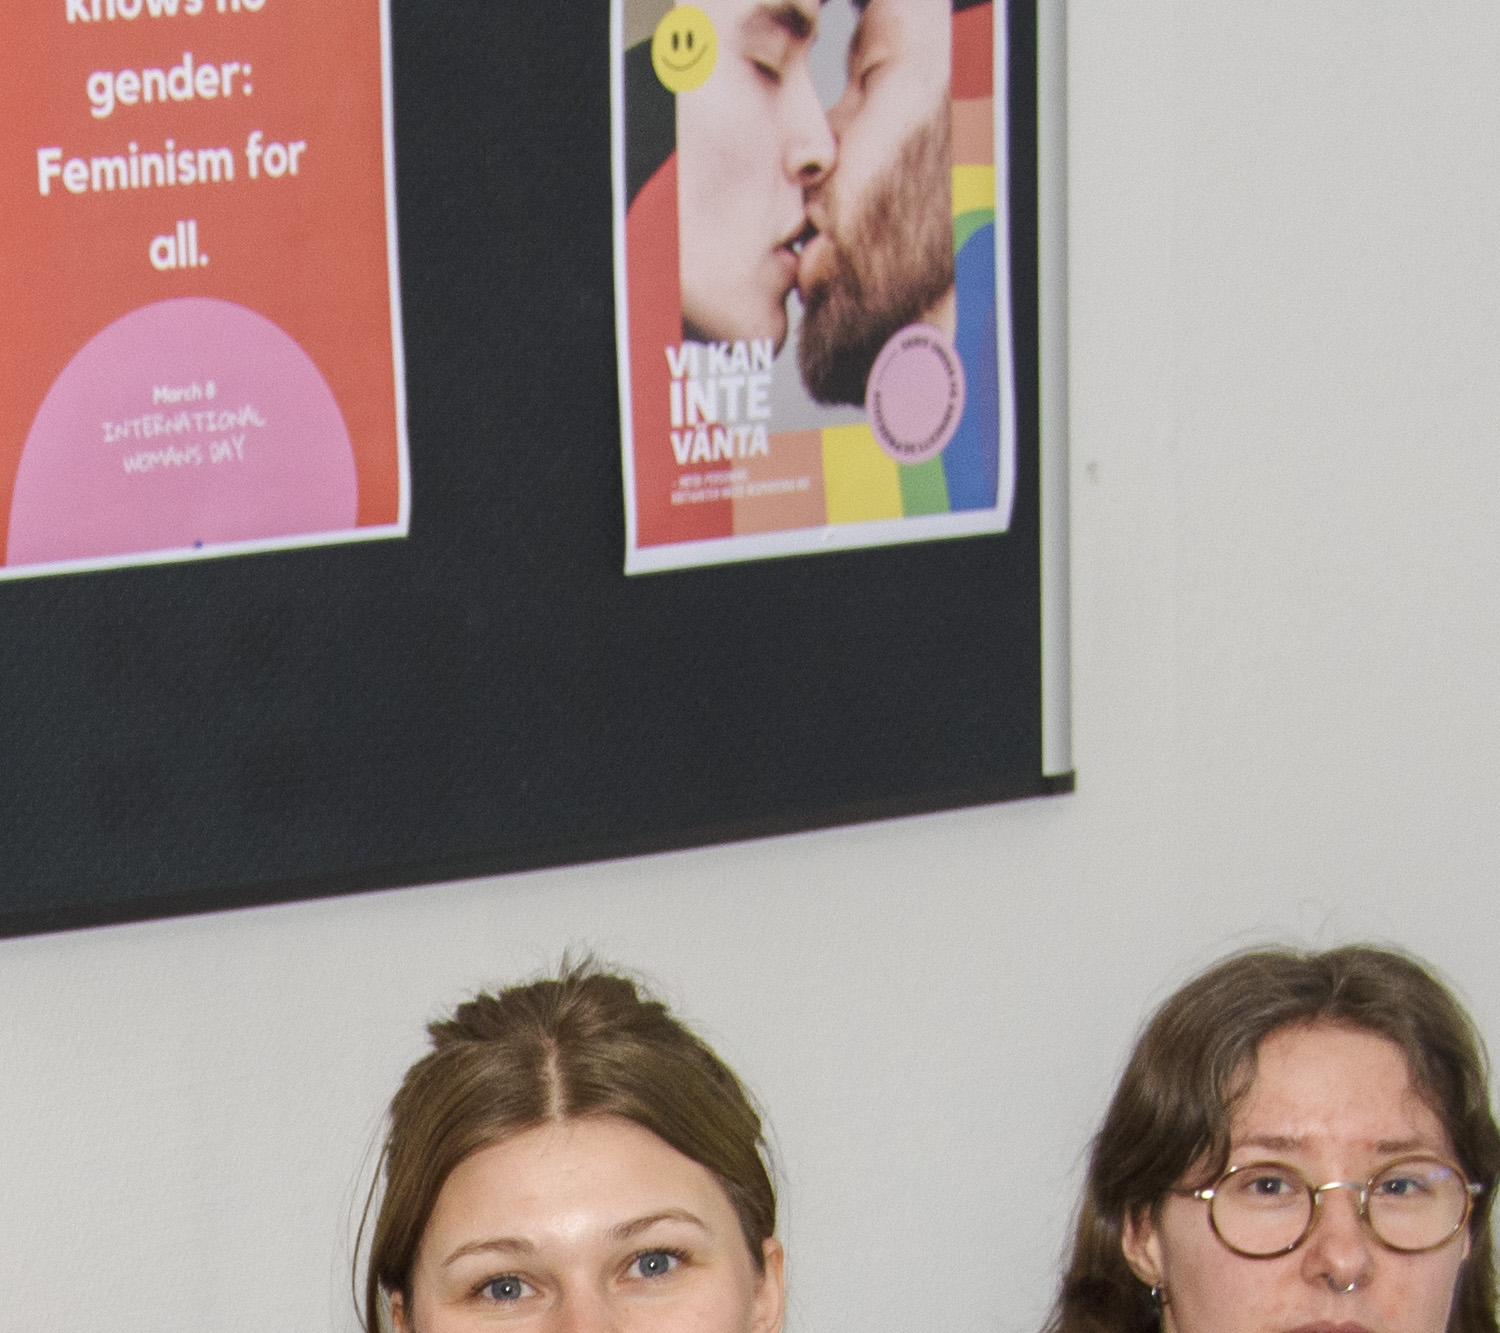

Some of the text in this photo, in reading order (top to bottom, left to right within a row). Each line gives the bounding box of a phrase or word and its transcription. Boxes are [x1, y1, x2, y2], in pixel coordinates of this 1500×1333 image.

[86, 51, 253, 119] gender:
[36, 129, 307, 197] Feminism for
[149, 218, 209, 270] all.
[665, 337, 774, 377] VI KAN
[102, 404, 266, 442] INTERNATIONAL
[669, 373, 772, 428] INTE
[209, 434, 245, 463] DAY
[670, 422, 769, 464] VÄNTA
